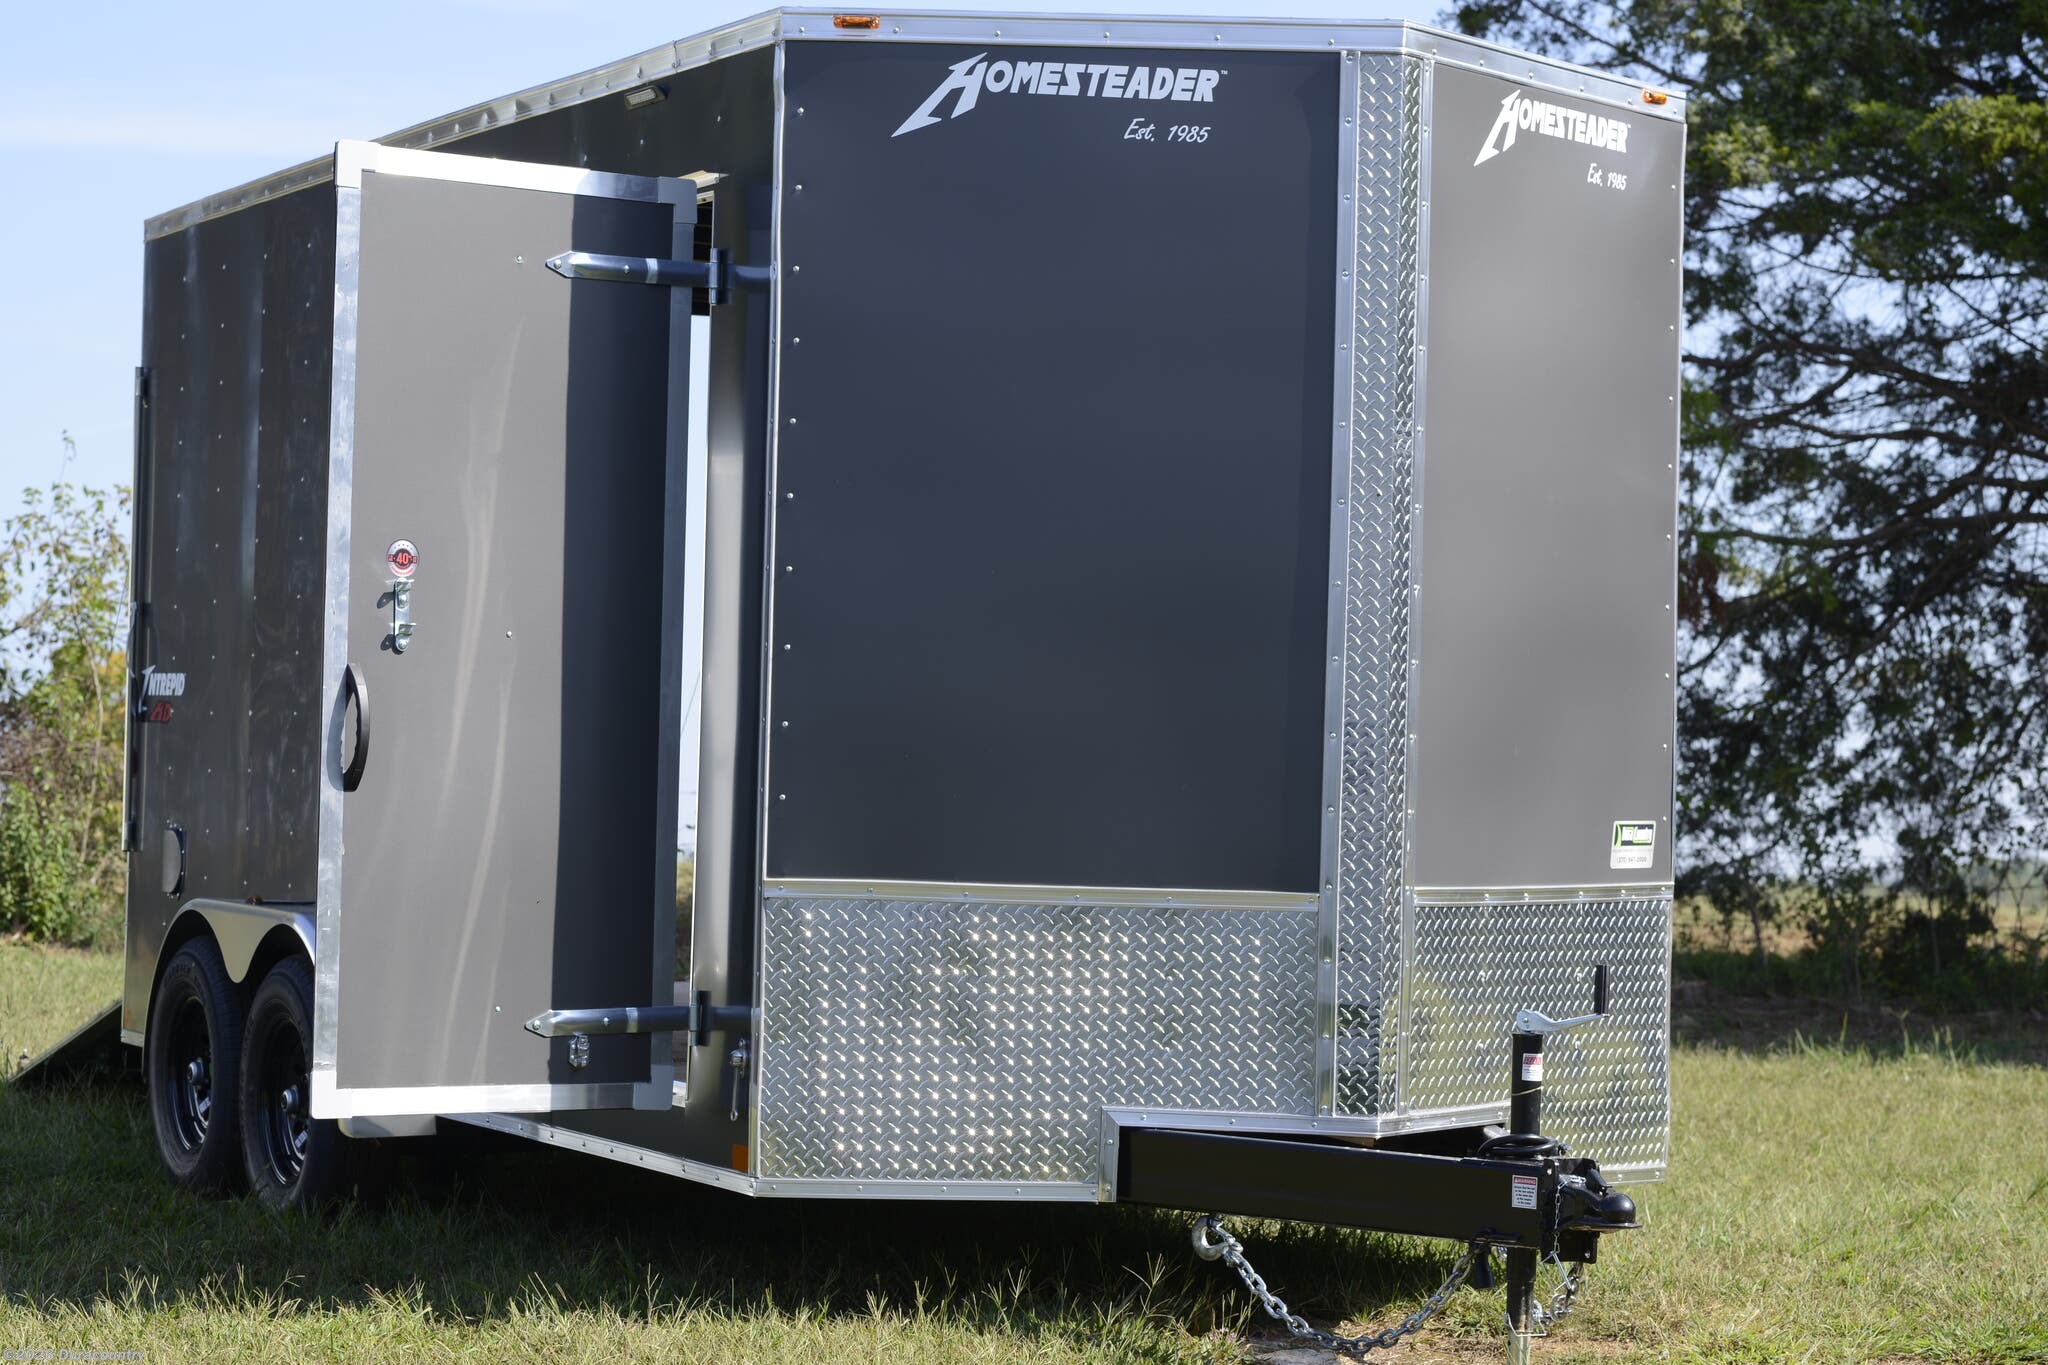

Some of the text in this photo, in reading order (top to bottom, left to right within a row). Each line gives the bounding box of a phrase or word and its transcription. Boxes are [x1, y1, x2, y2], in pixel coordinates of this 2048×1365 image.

[891, 52, 1220, 137] HOMESTEADER
[1123, 117, 1211, 143] Est. 1985
[1473, 89, 1629, 167] HOMESTEADER
[1587, 163, 1628, 190] Est. 1985
